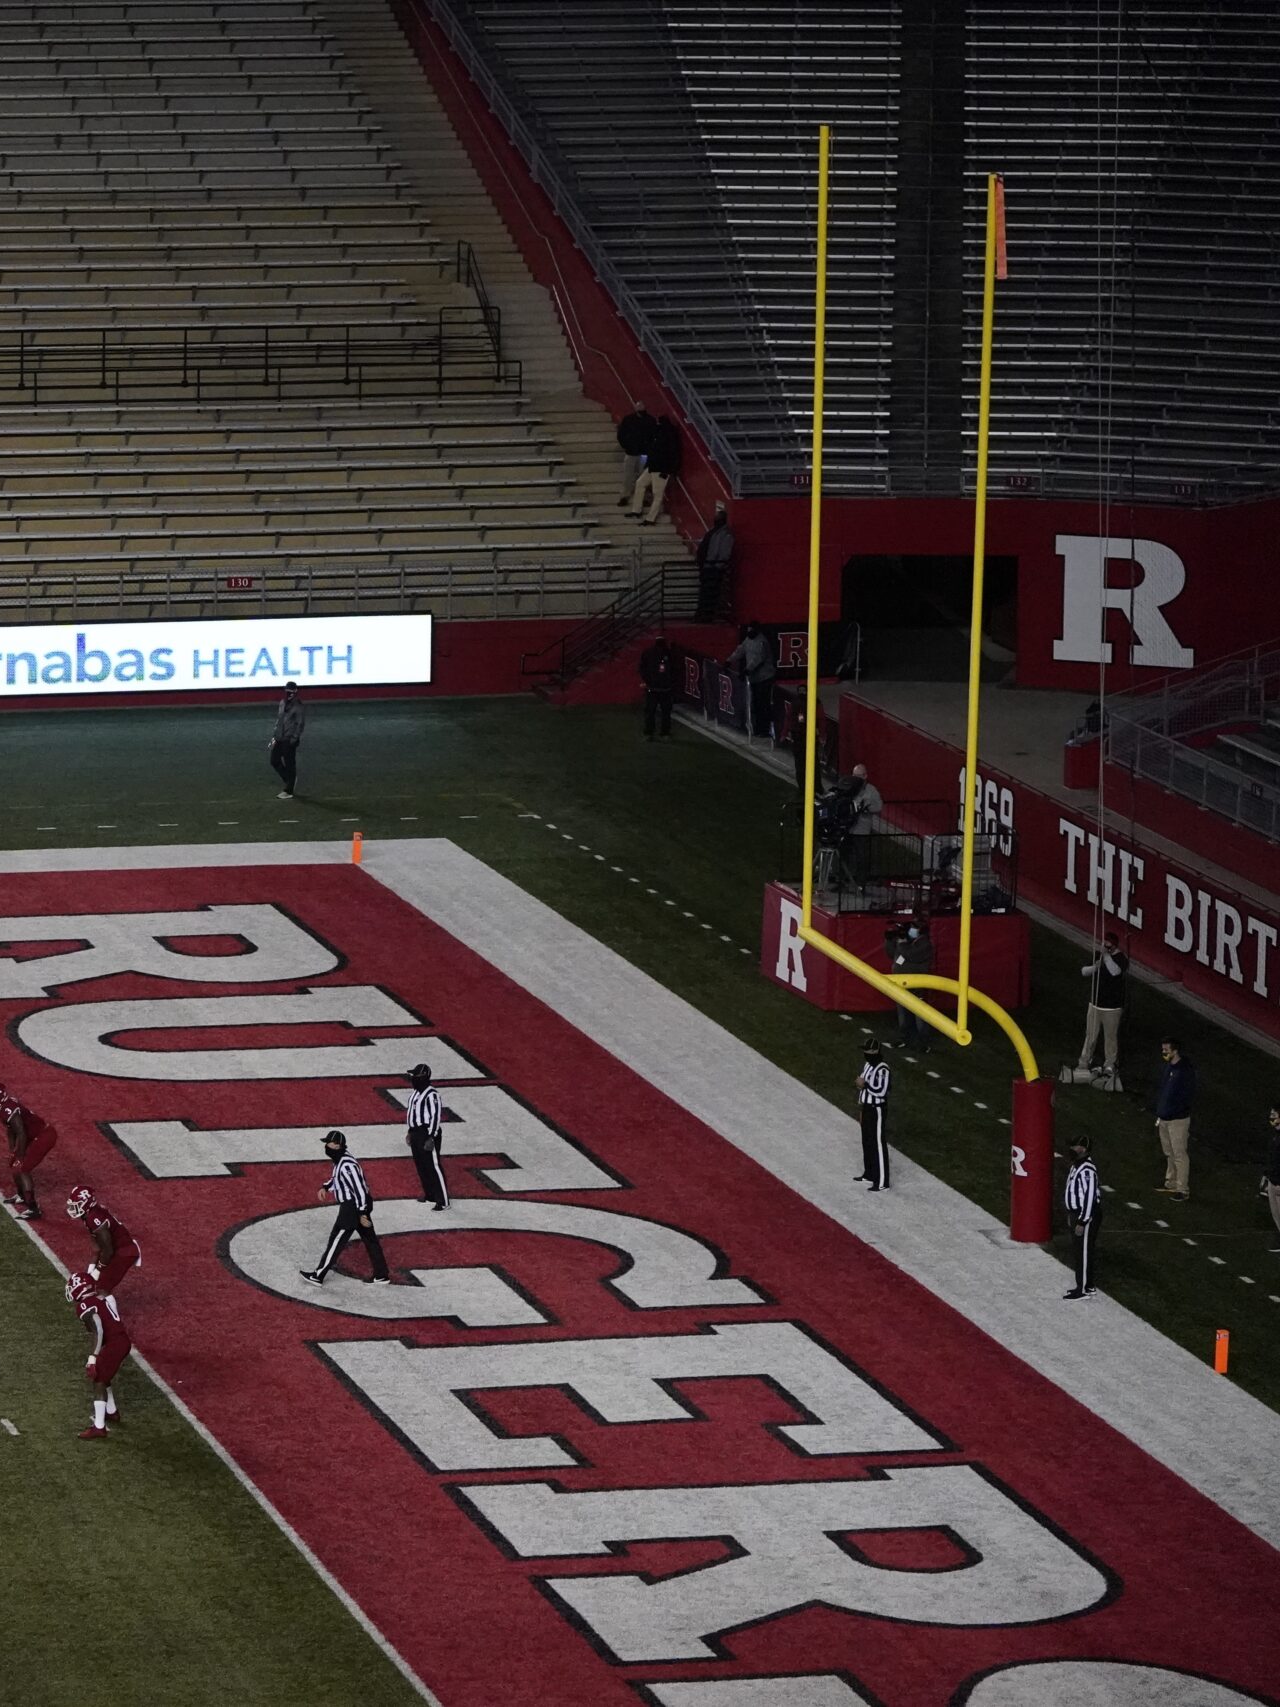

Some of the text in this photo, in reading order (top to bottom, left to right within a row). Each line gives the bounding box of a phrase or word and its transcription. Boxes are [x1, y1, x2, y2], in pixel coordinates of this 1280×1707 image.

[231, 577, 249, 587] 130
[1053, 534, 1195, 669] R
[194, 645, 354, 679] HEALTH
[776, 631, 809, 668] R
[1059, 817, 1278, 998] THE BIRT
[775, 896, 808, 993] R
[1011, 1144, 1028, 1177] R
